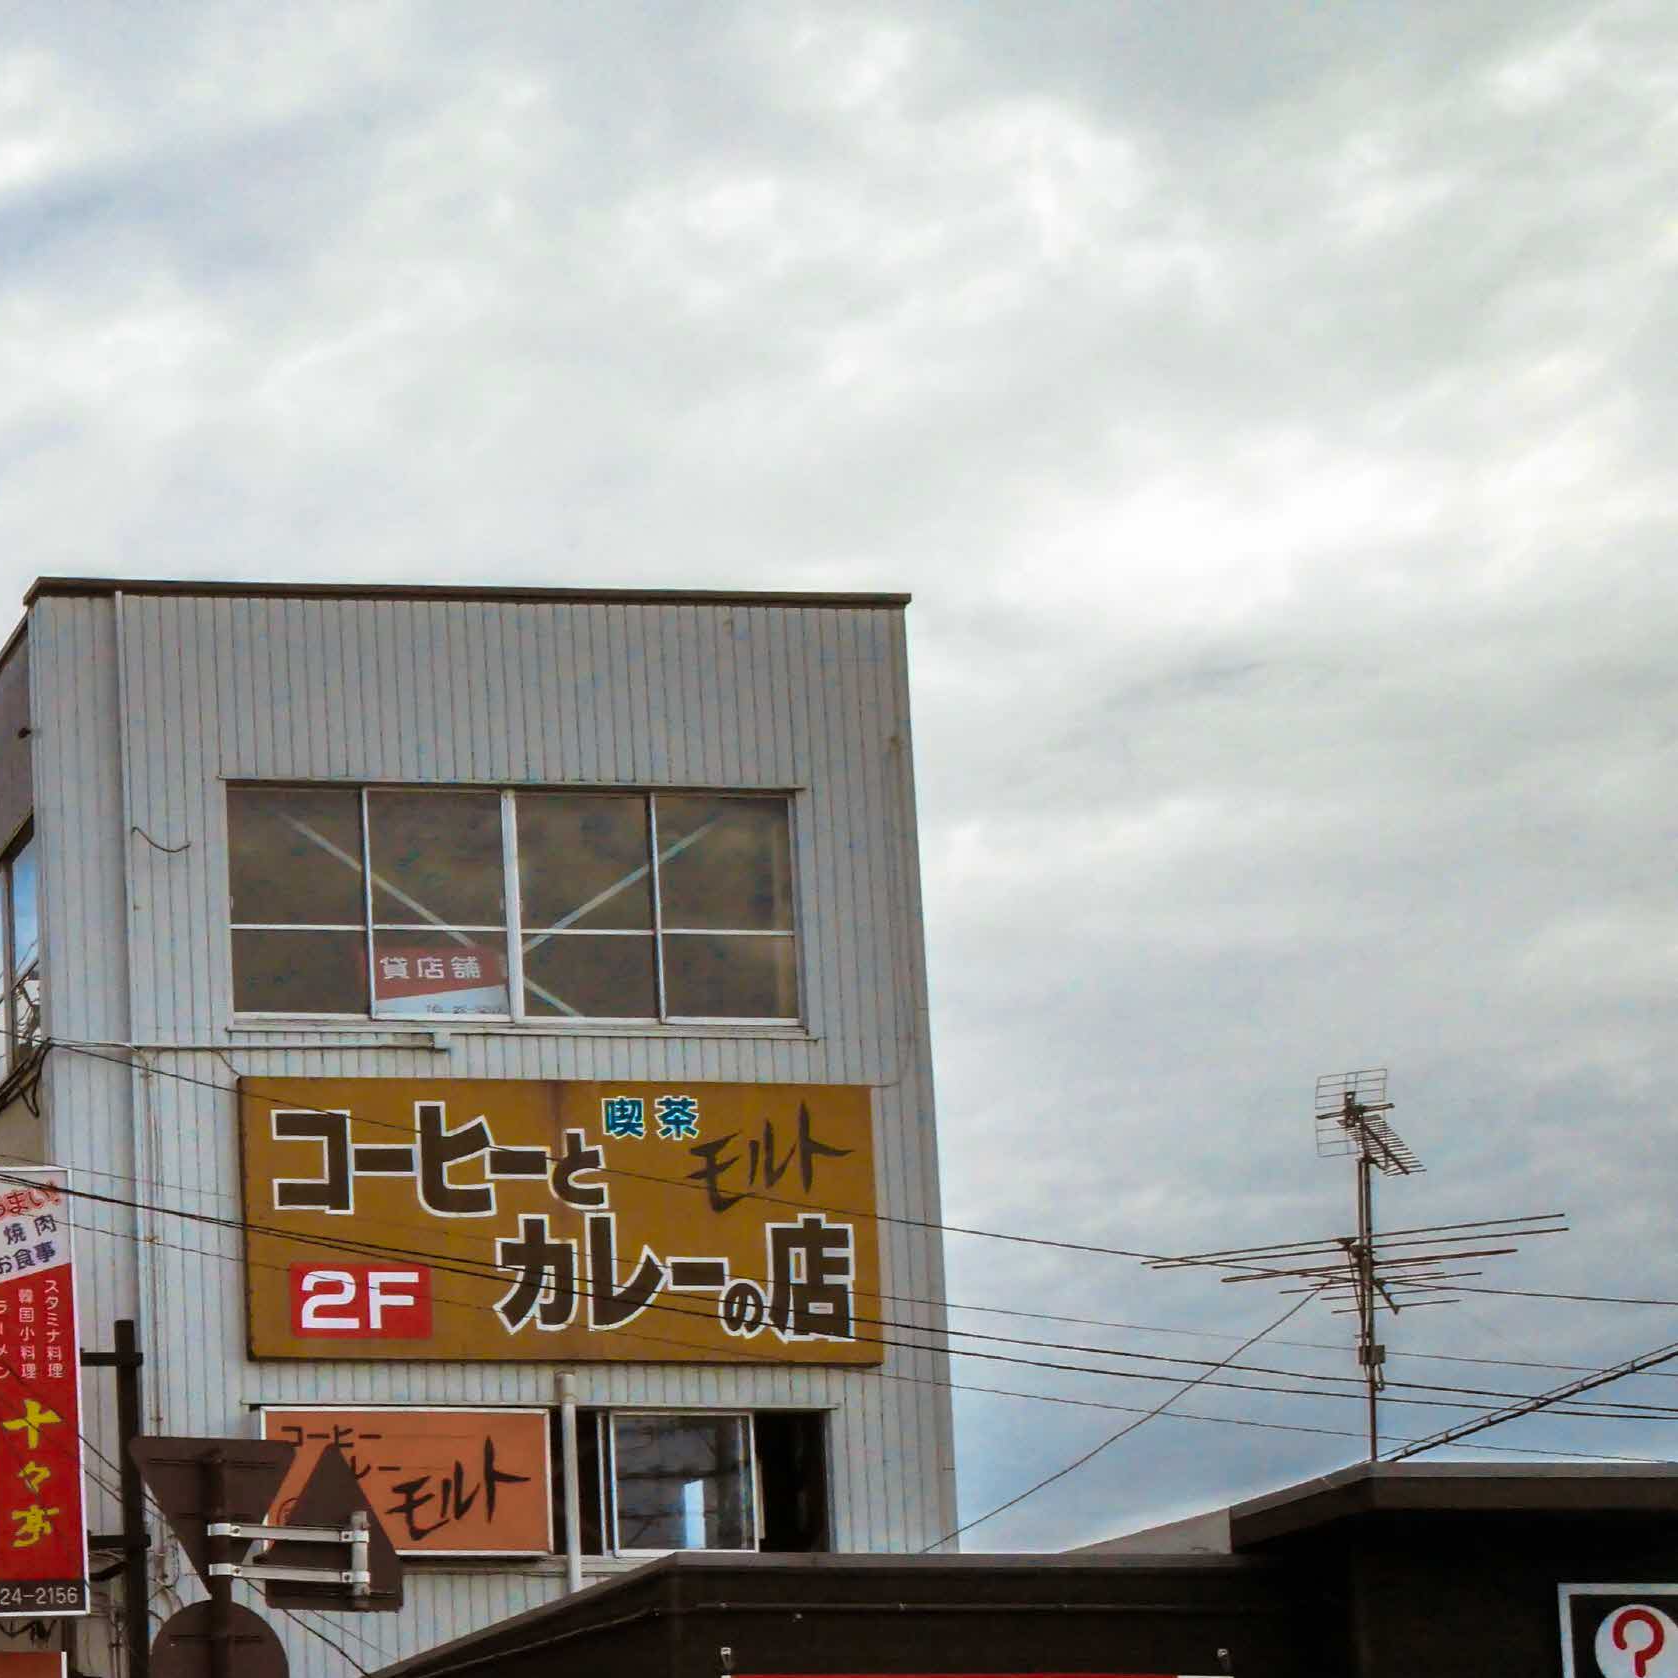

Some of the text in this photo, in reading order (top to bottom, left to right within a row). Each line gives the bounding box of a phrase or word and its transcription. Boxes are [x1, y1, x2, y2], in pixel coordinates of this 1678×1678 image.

[602, 1096, 700, 1140] 喫茶
[271, 1101, 610, 1217] コーヒーと
[685, 1102, 854, 1212] モルト
[4, 1213, 57, 1245] 焼肉
[300, 1271, 420, 1329] 2F
[493, 1213, 856, 1343] カレーの店
[18, 1288, 37, 1380] 韓国小料理
[44, 1279, 64, 1379] スタミナ料理
[281, 1424, 382, 1449] コーヒー
[350, 1456, 401, 1480] レー
[386, 1435, 532, 1542] モルト
[0, 1587, 79, 1606] 24-2156
